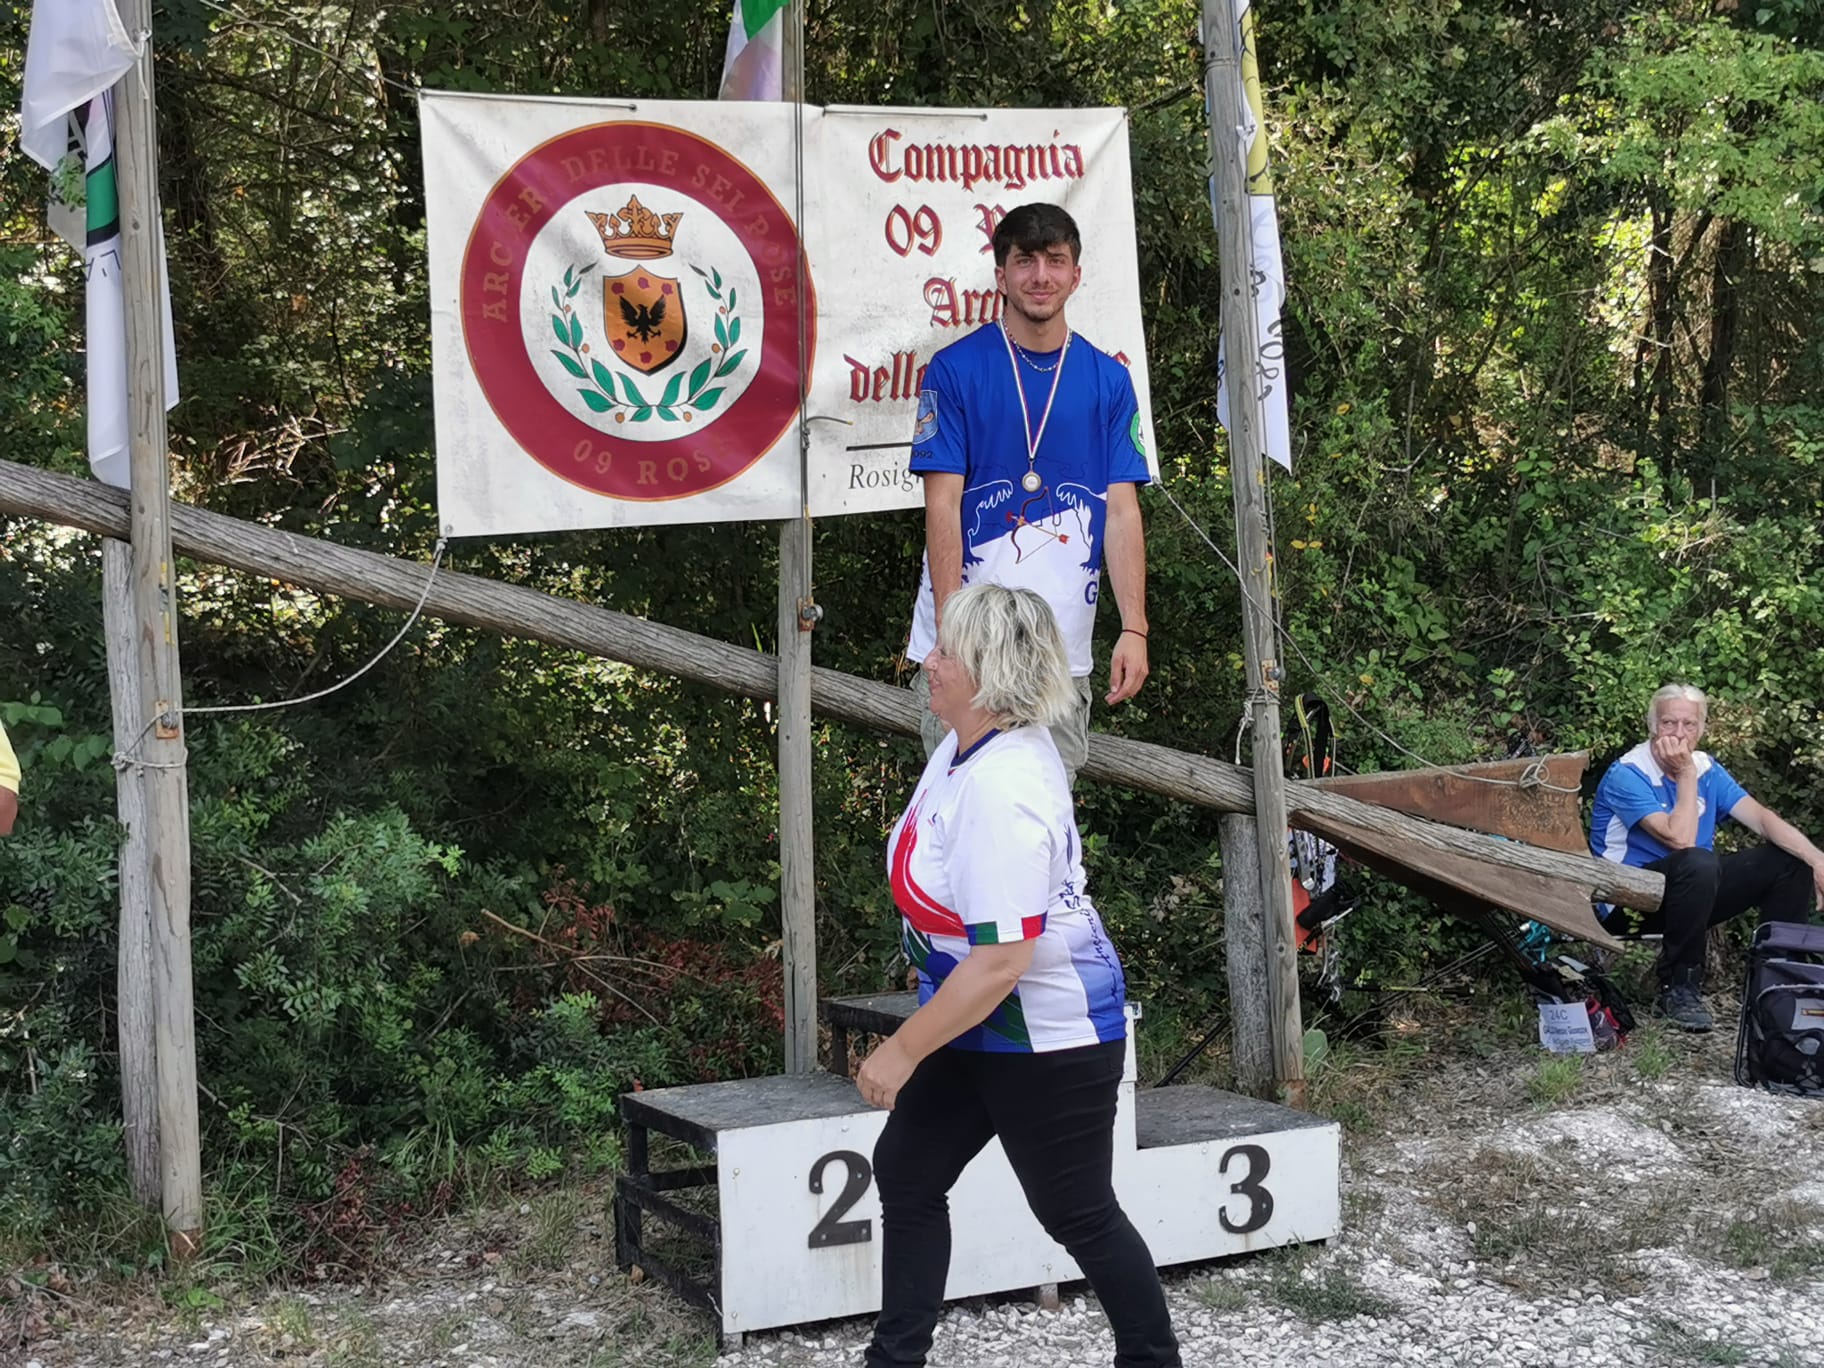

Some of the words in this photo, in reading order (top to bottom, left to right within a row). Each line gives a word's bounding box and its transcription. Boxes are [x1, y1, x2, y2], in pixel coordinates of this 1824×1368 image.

[561, 146, 681, 184] DELLE
[692, 163, 745, 213] SEI
[868, 128, 1085, 193] Compagnia
[885, 204, 943, 257] 09
[574, 439, 612, 475] 09
[847, 461, 919, 492] Rosig
[808, 1149, 873, 1248] 2
[1219, 1144, 1275, 1234] 3
